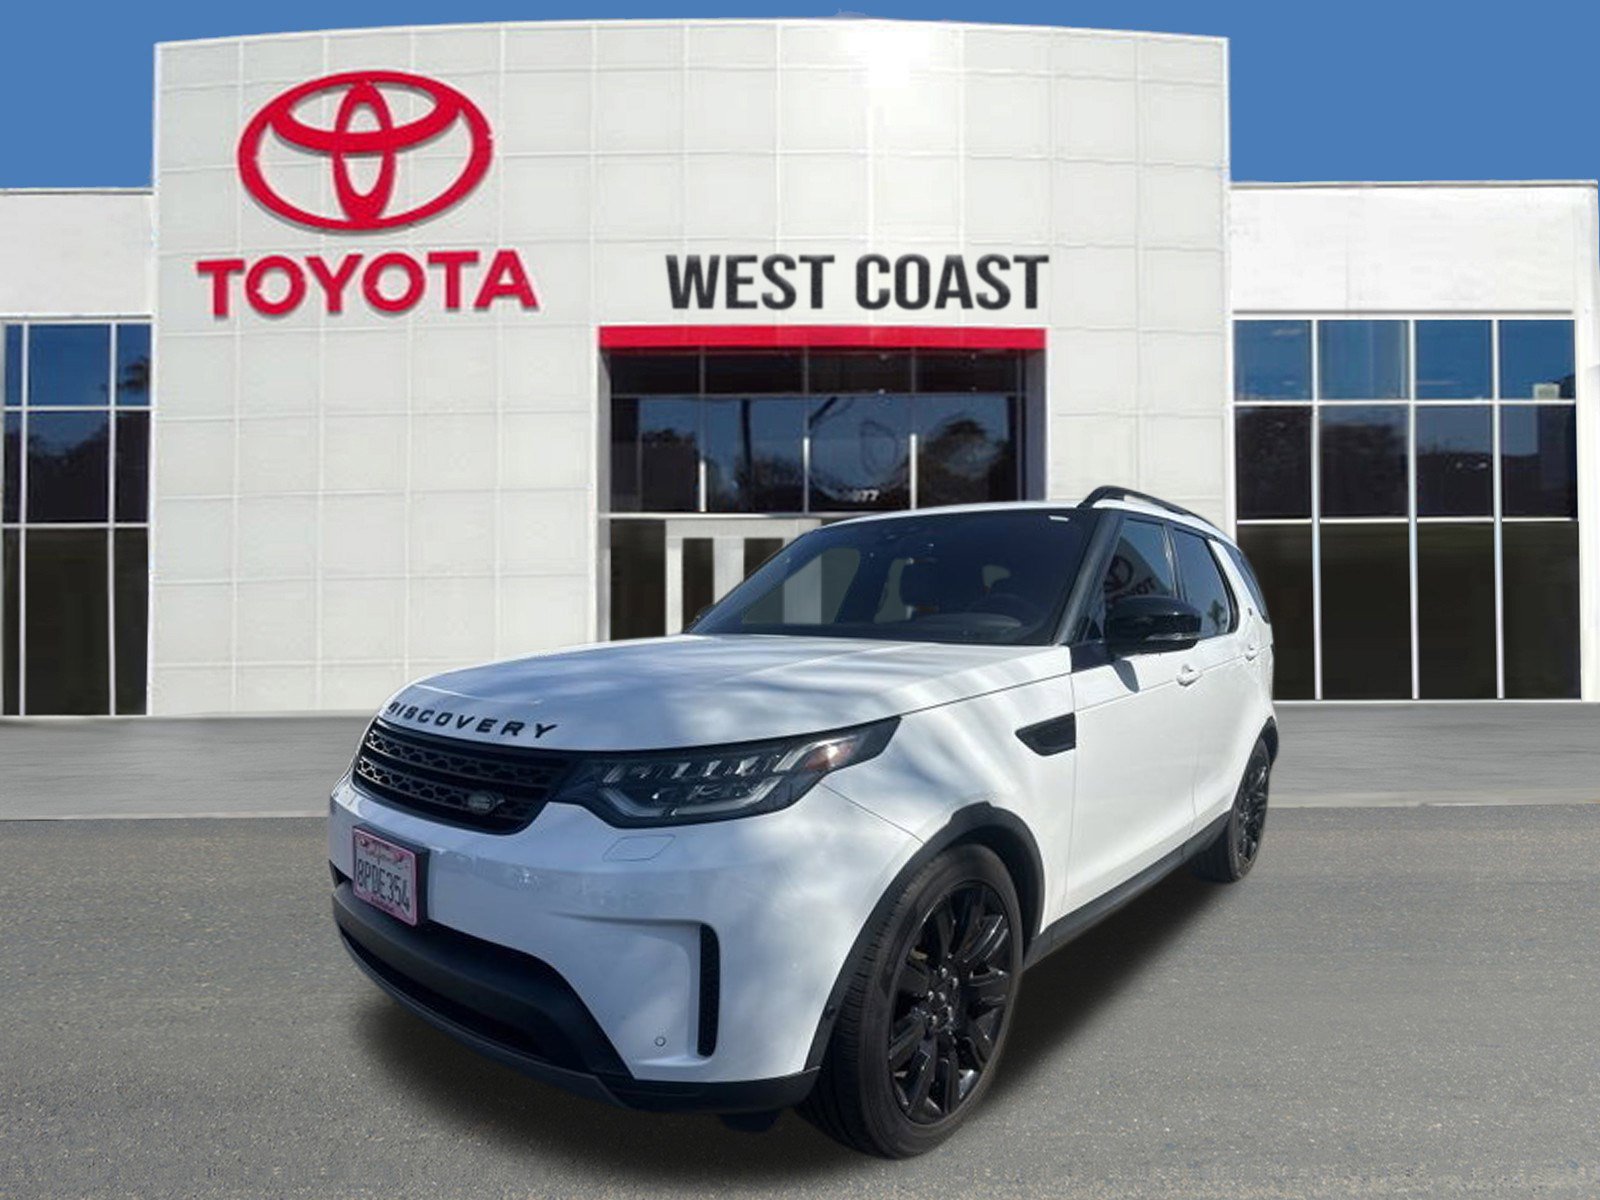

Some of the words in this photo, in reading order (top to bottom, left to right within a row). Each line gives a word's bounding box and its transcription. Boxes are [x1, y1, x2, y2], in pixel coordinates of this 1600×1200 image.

[197, 250, 539, 317] TOYOTA
[666, 253, 835, 310] WEST
[856, 253, 1050, 310] COAST
[388, 701, 558, 738] DISCOVERY
